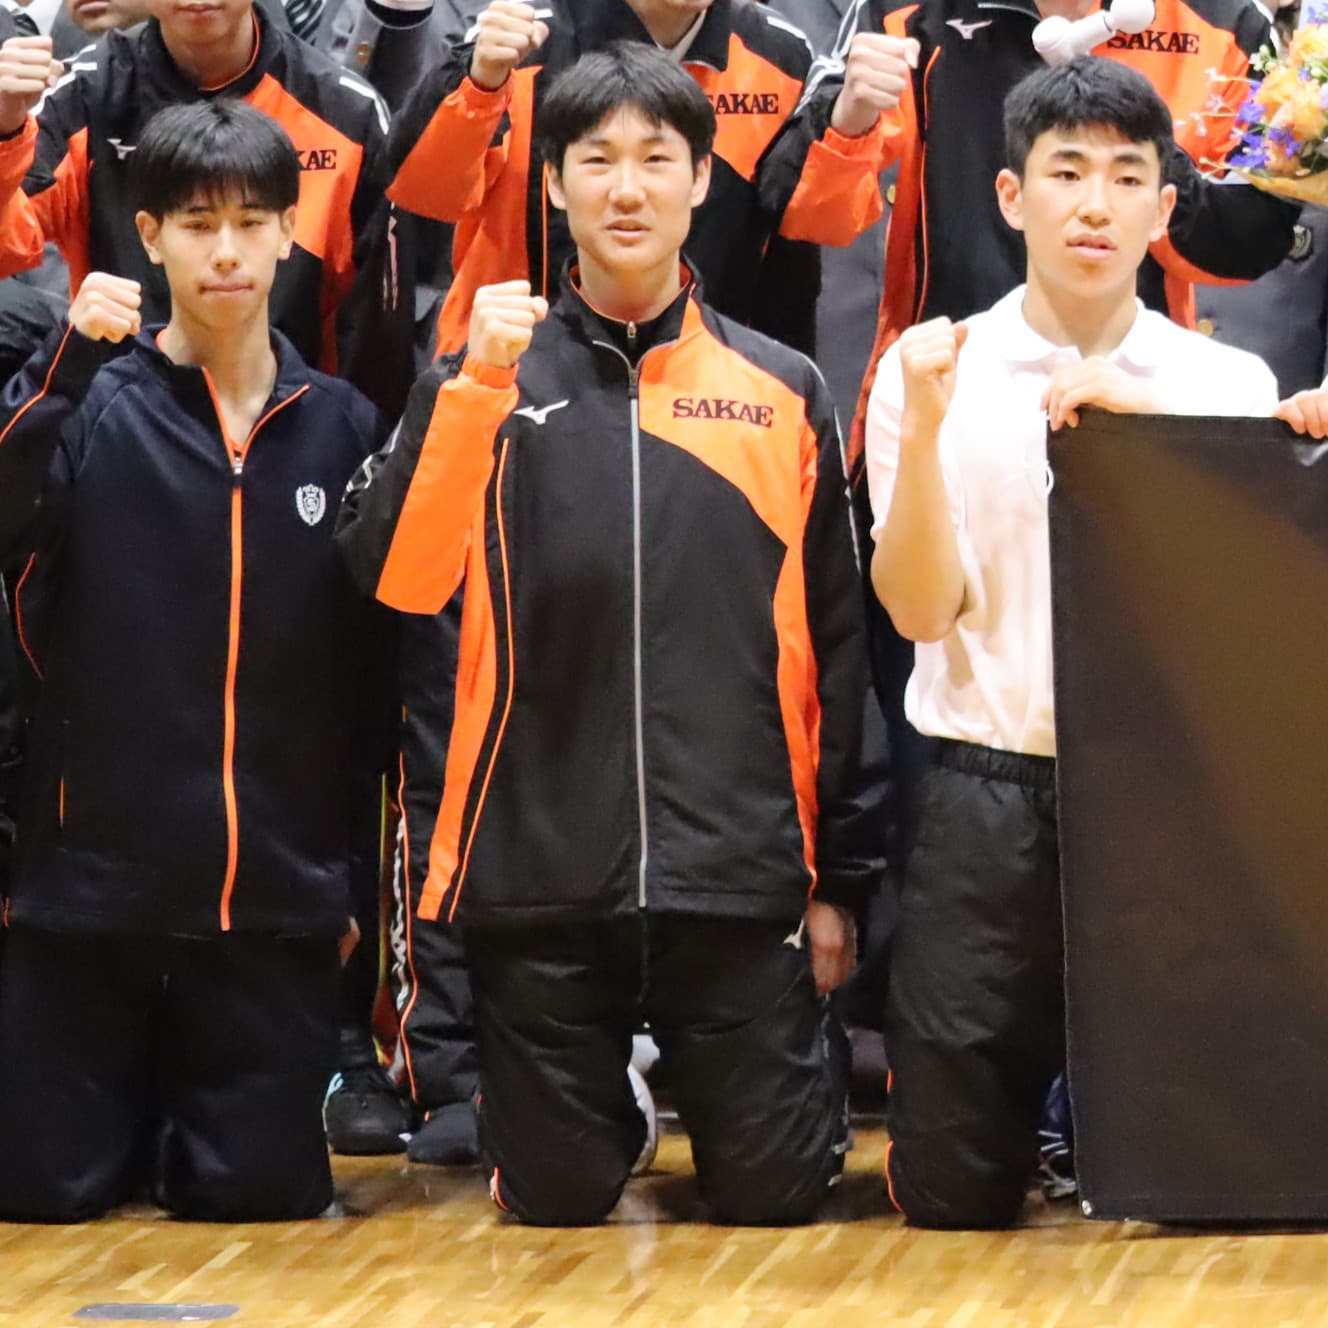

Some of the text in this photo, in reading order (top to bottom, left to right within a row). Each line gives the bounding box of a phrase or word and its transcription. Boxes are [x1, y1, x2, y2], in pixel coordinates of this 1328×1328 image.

[1106, 29, 1200, 54] SAKAE
[705, 92, 779, 115] AKAE
[294, 149, 337, 171] KAE
[672, 397, 774, 429] SAKAE
